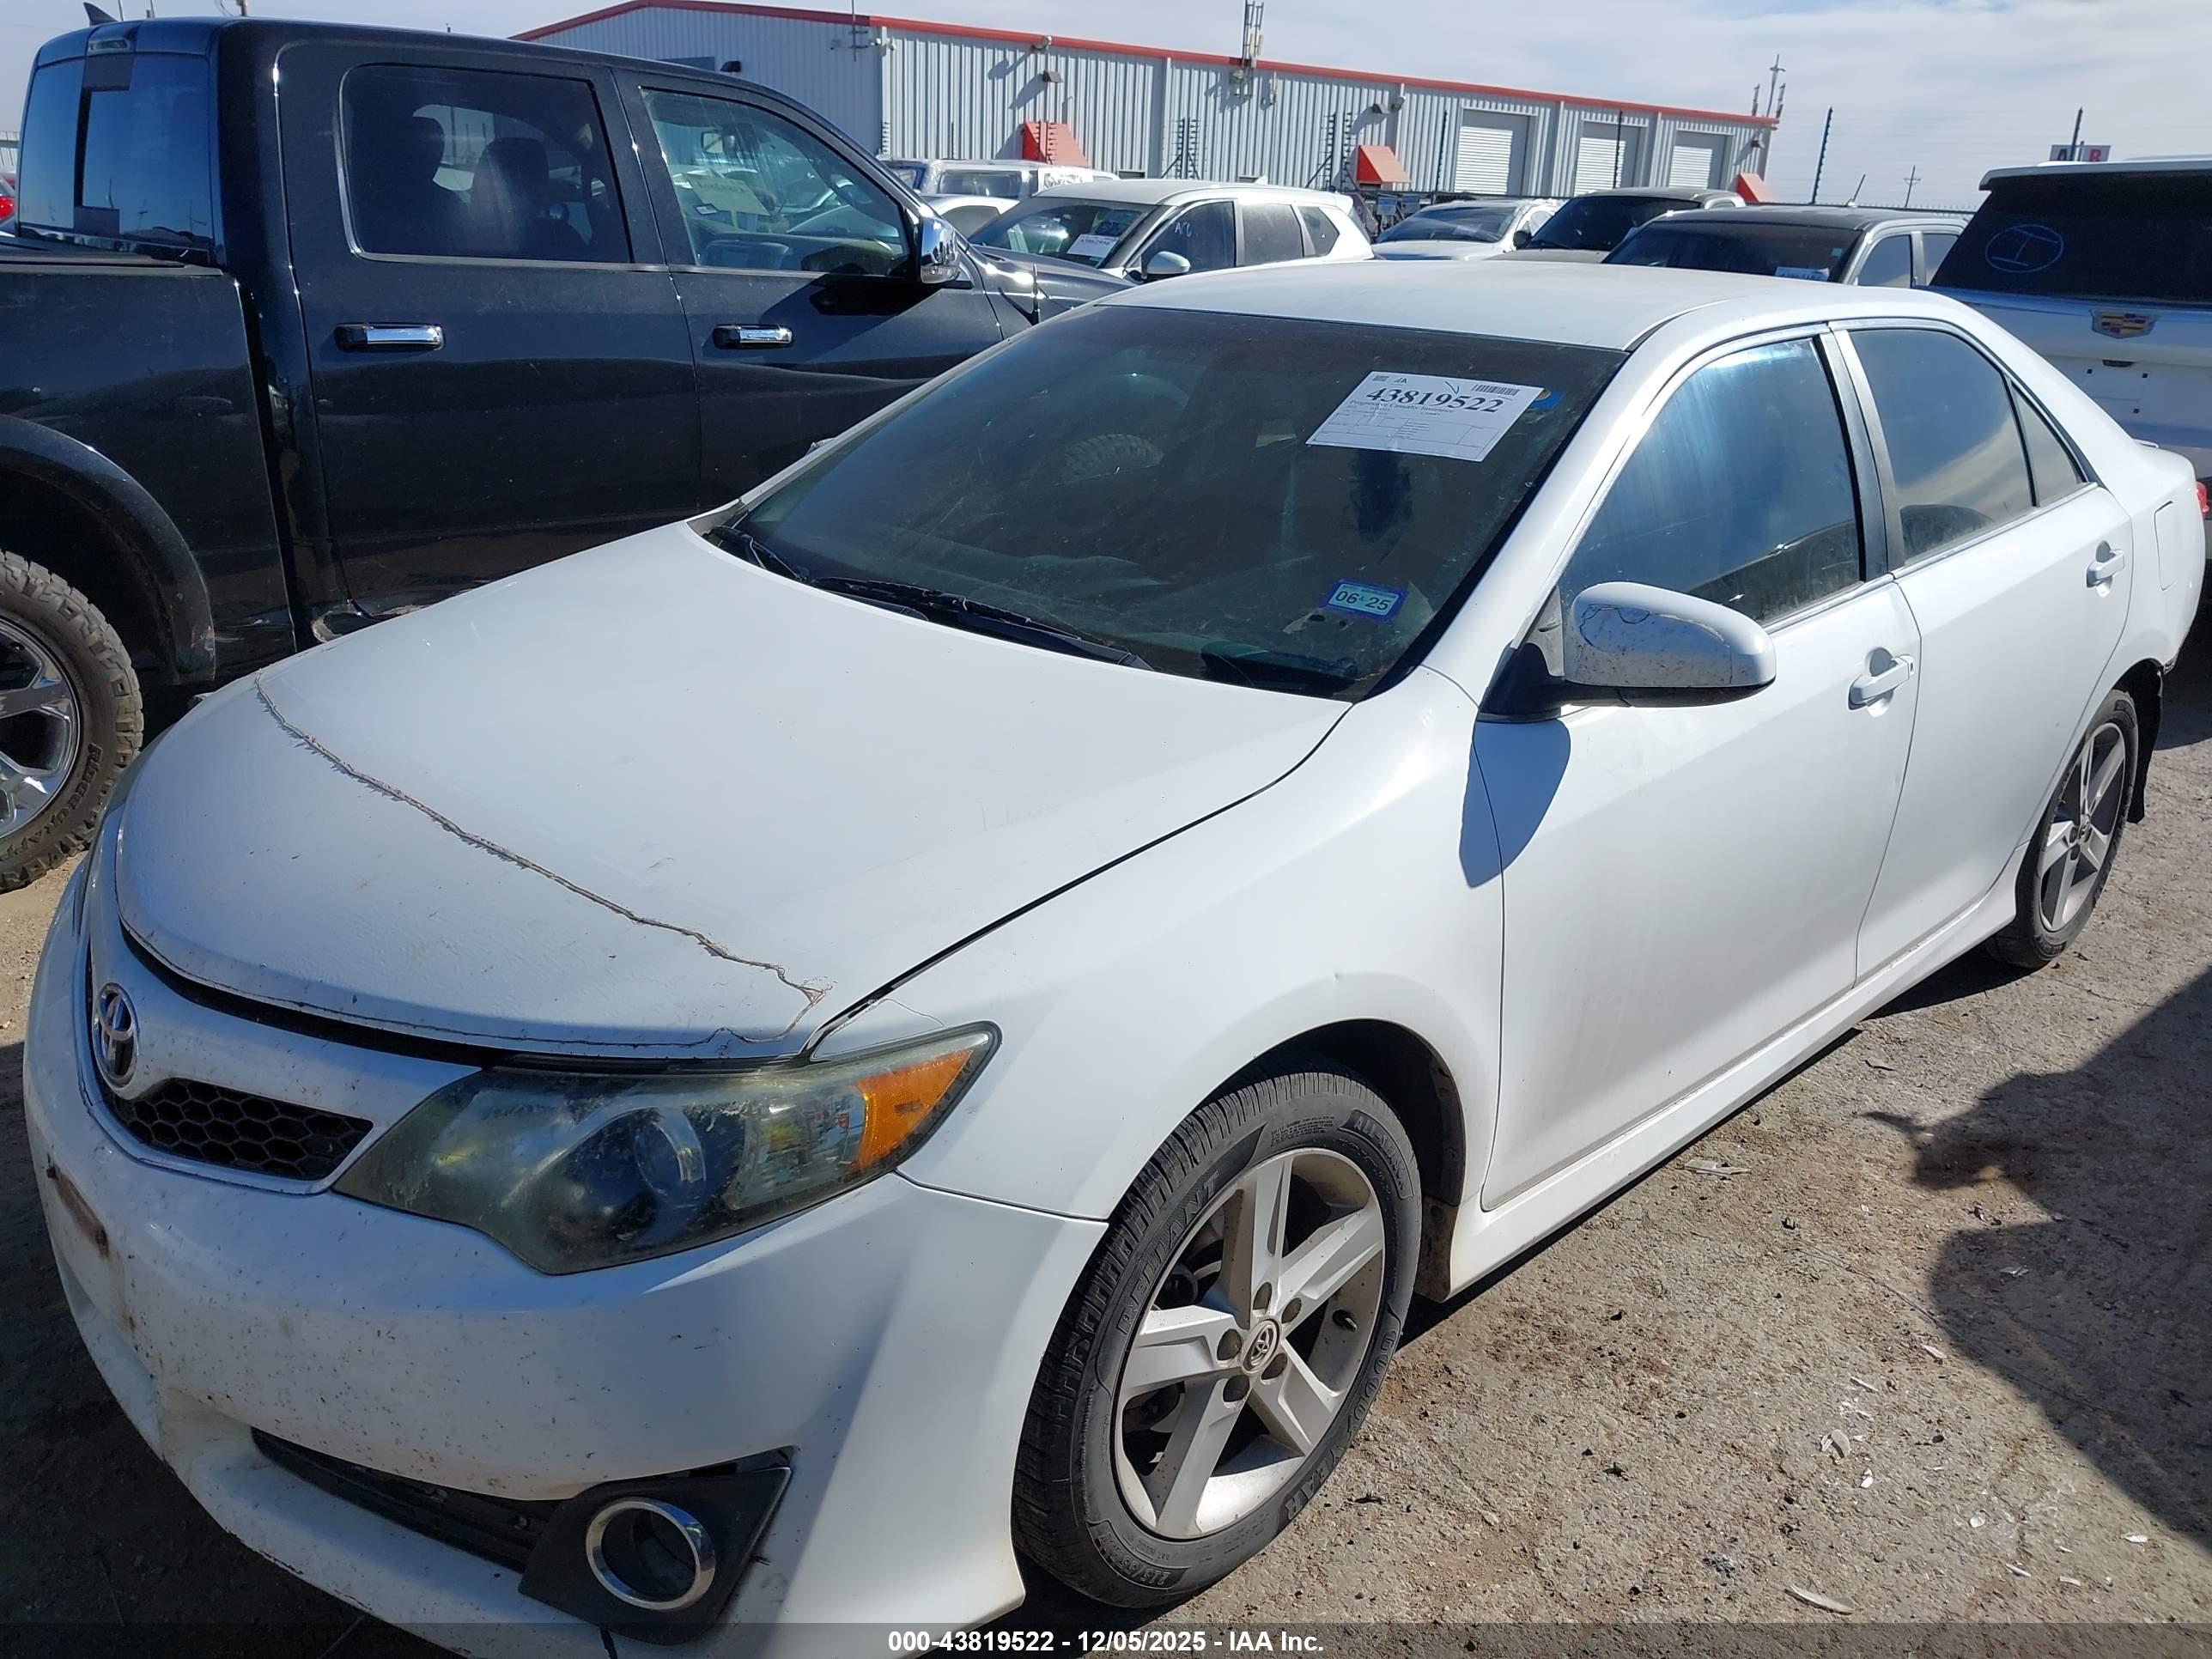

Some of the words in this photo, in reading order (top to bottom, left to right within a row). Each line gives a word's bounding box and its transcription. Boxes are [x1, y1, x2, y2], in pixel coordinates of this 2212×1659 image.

[1366, 388, 1504, 413] 43819522
[1335, 591, 1359, 604] 06
[1364, 597, 1391, 611] 25
[1117, 1170, 1218, 1335] RELIANT
